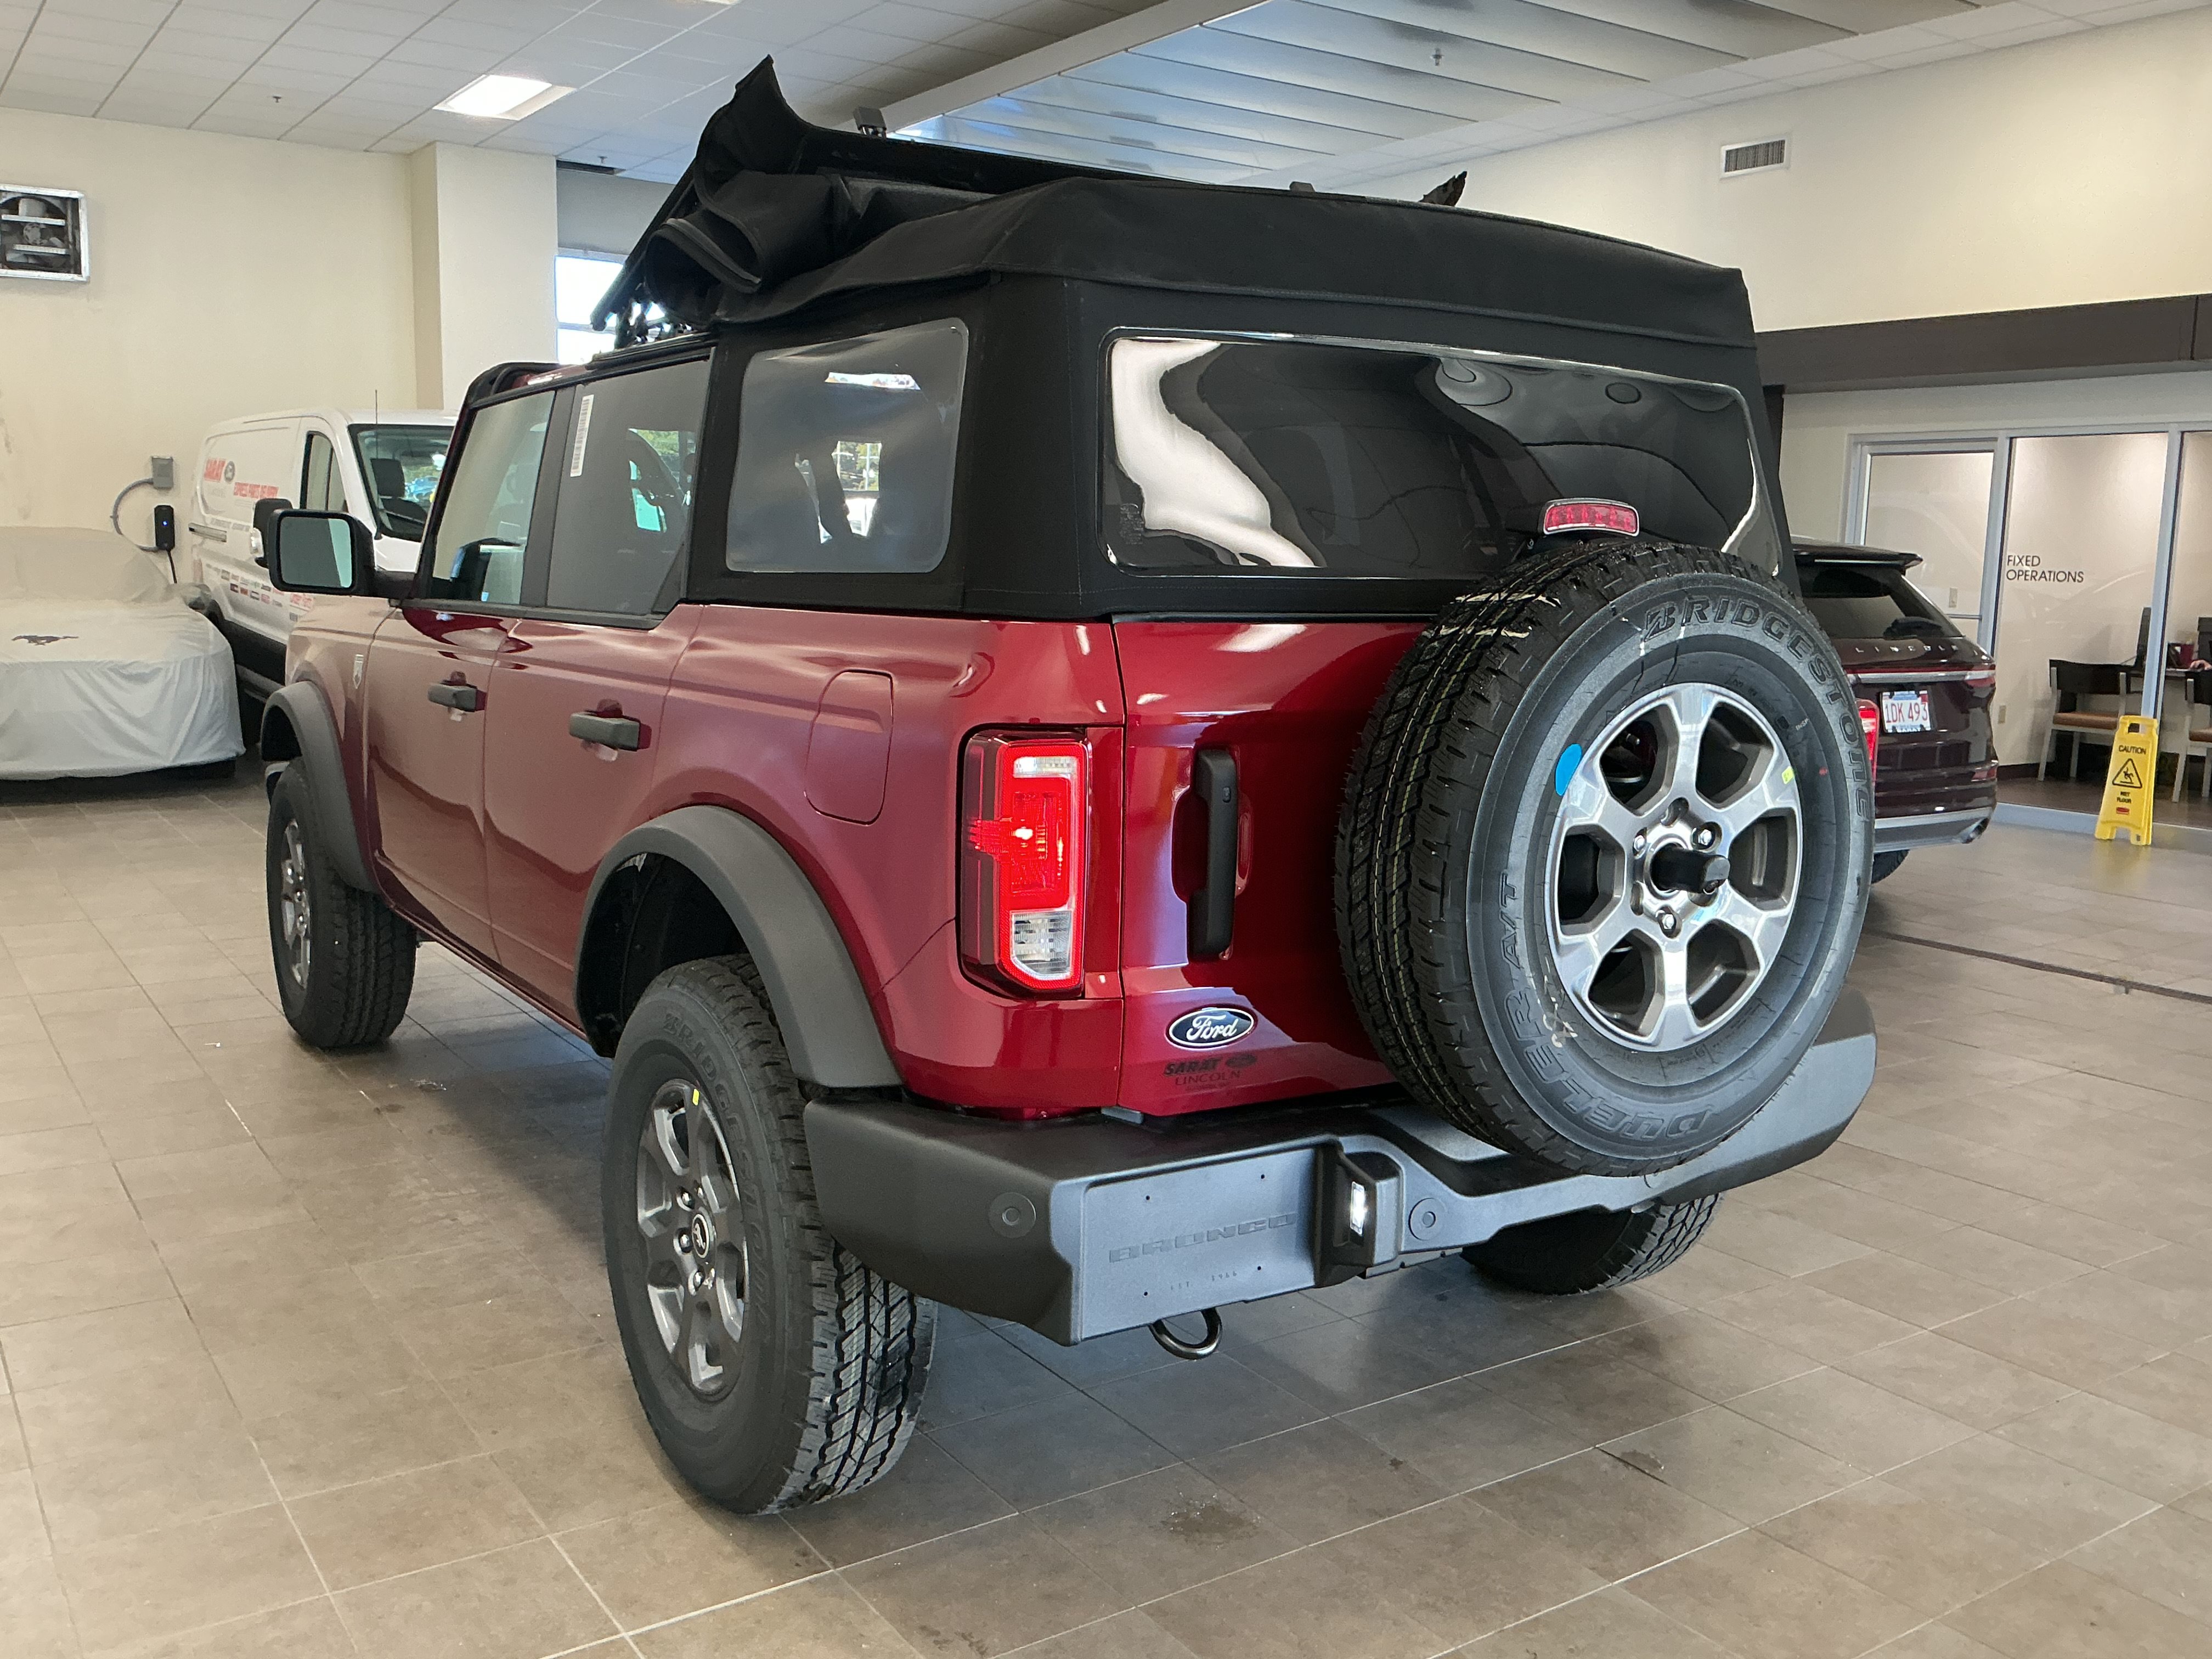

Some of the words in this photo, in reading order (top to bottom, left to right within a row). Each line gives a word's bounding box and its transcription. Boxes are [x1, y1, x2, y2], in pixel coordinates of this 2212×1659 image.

[2007, 555, 2041, 567] FIXED
[2006, 569, 2085, 583] OPERATIONS
[1855, 645, 1959, 653] LINCOLN
[1644, 595, 1871, 822] BRIDGESTONE
[1885, 704, 1905, 724] 1DK
[1908, 702, 1928, 723] 493
[2118, 744, 2147, 755] CAUTION
[1186, 1014, 1239, 1041] Ford
[1164, 1056, 1223, 1076] SARAT
[1504, 989, 1711, 1141] DUELER
[1175, 1070, 1240, 1086] LINCOLN
[1109, 1212, 1297, 1263] BRONCO
